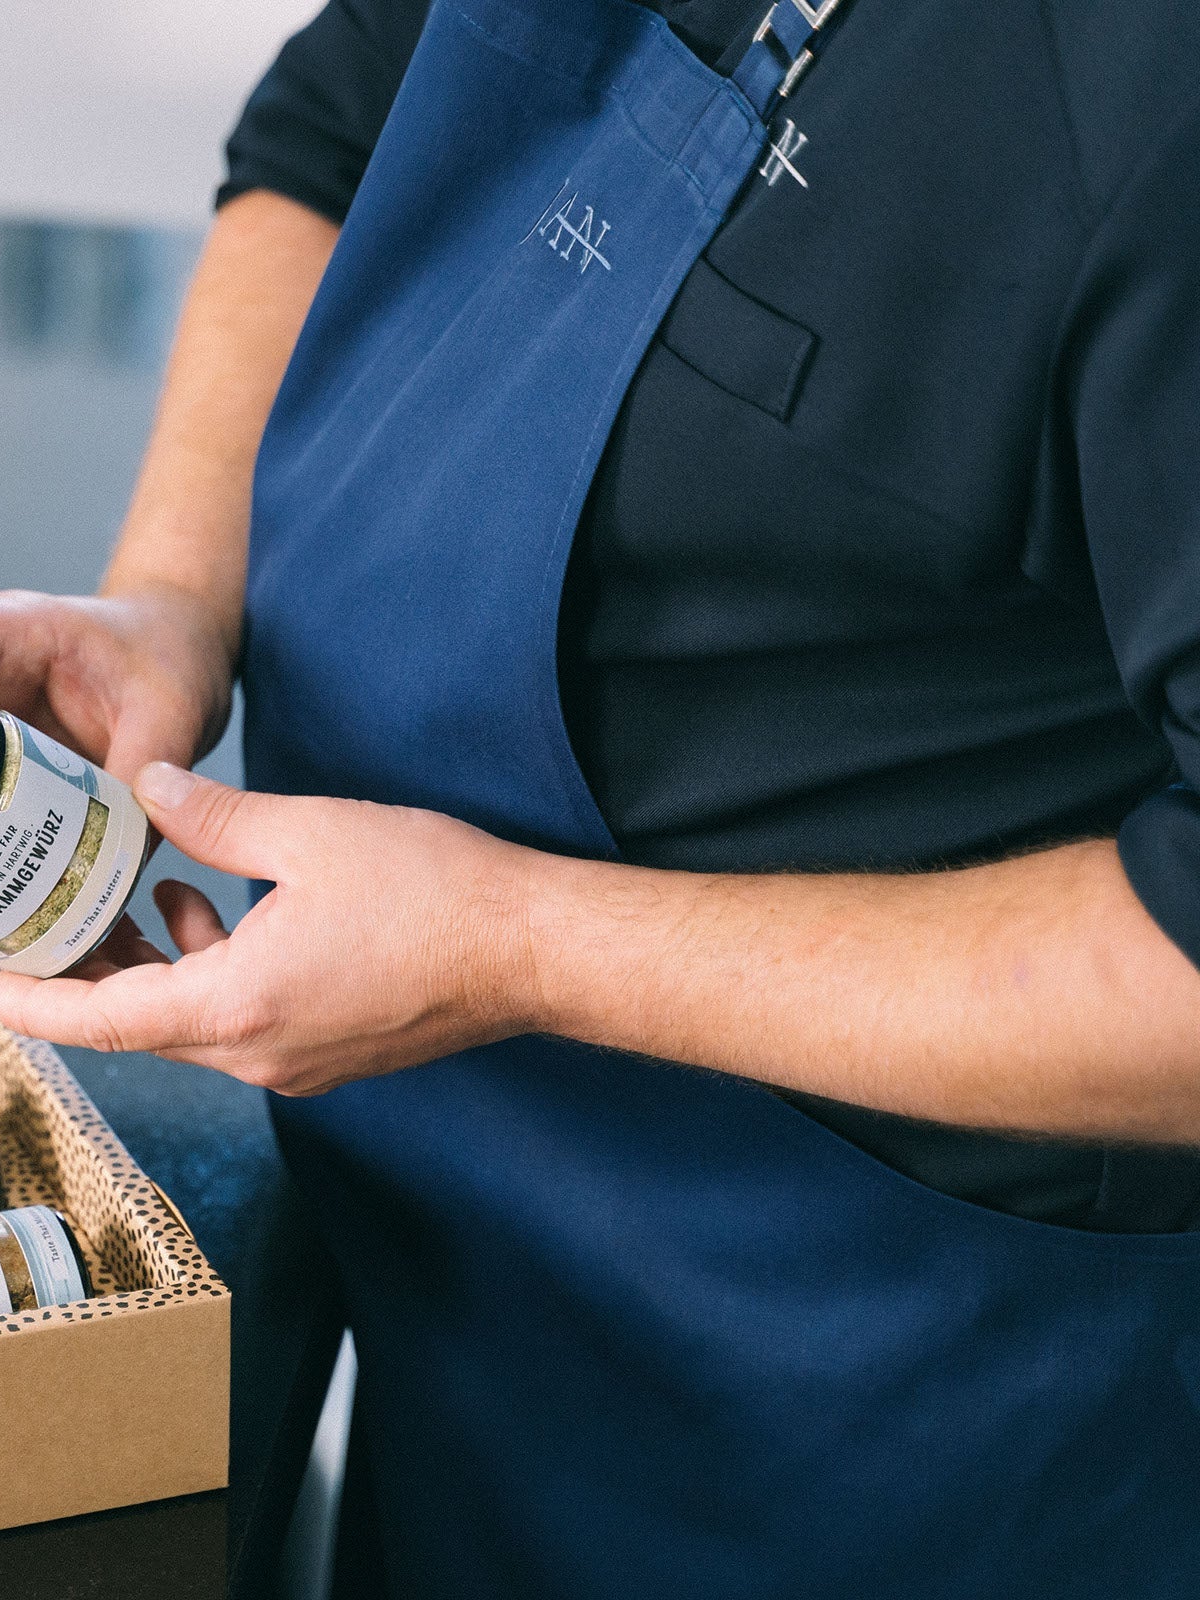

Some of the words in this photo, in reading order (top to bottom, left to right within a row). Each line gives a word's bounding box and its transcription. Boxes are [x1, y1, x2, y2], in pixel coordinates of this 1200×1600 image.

[2, 829, 33, 871] HARTWIG
[64, 927, 87, 947] Taste
[82, 907, 102, 927] That
[98, 869, 122, 906] Matters
[48, 1240, 61, 1262] Taste
